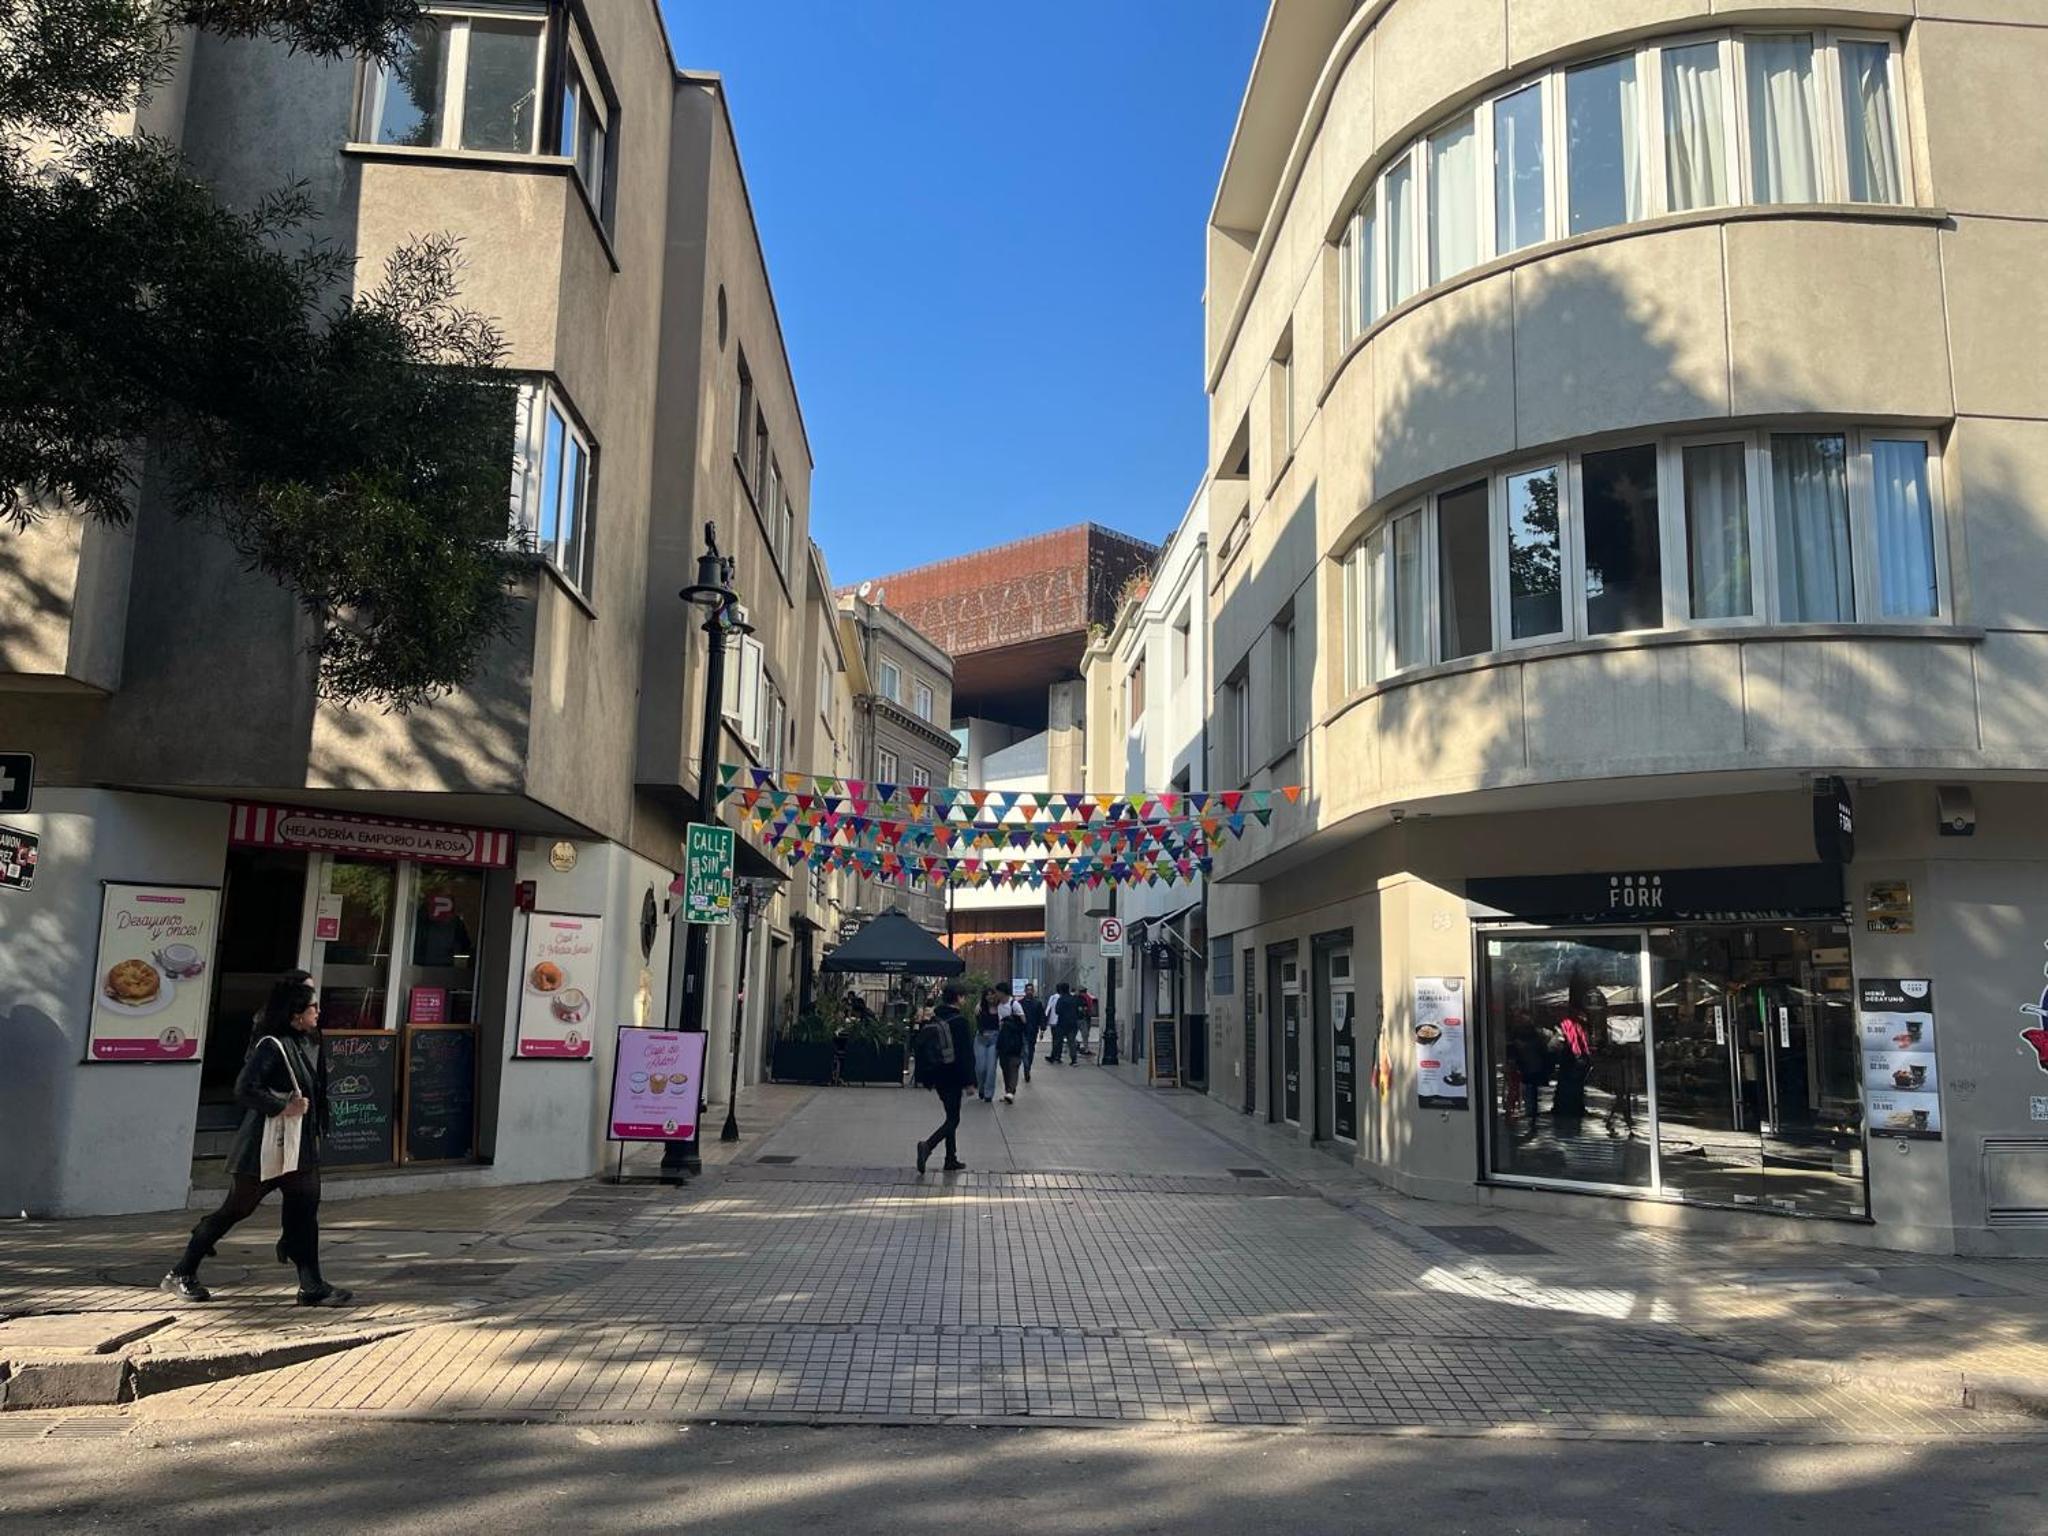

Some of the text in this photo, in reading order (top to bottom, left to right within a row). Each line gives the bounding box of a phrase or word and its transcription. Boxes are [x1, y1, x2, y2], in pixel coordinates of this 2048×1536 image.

[286, 824, 468, 853] HELADERÍA EMPORIO LA ROSA
[693, 831, 728, 852] CALLE
[701, 855, 719, 874] SIN
[1609, 887, 1663, 908] FORK
[116, 910, 183, 930] Desayunos
[151, 926, 162, 941] y
